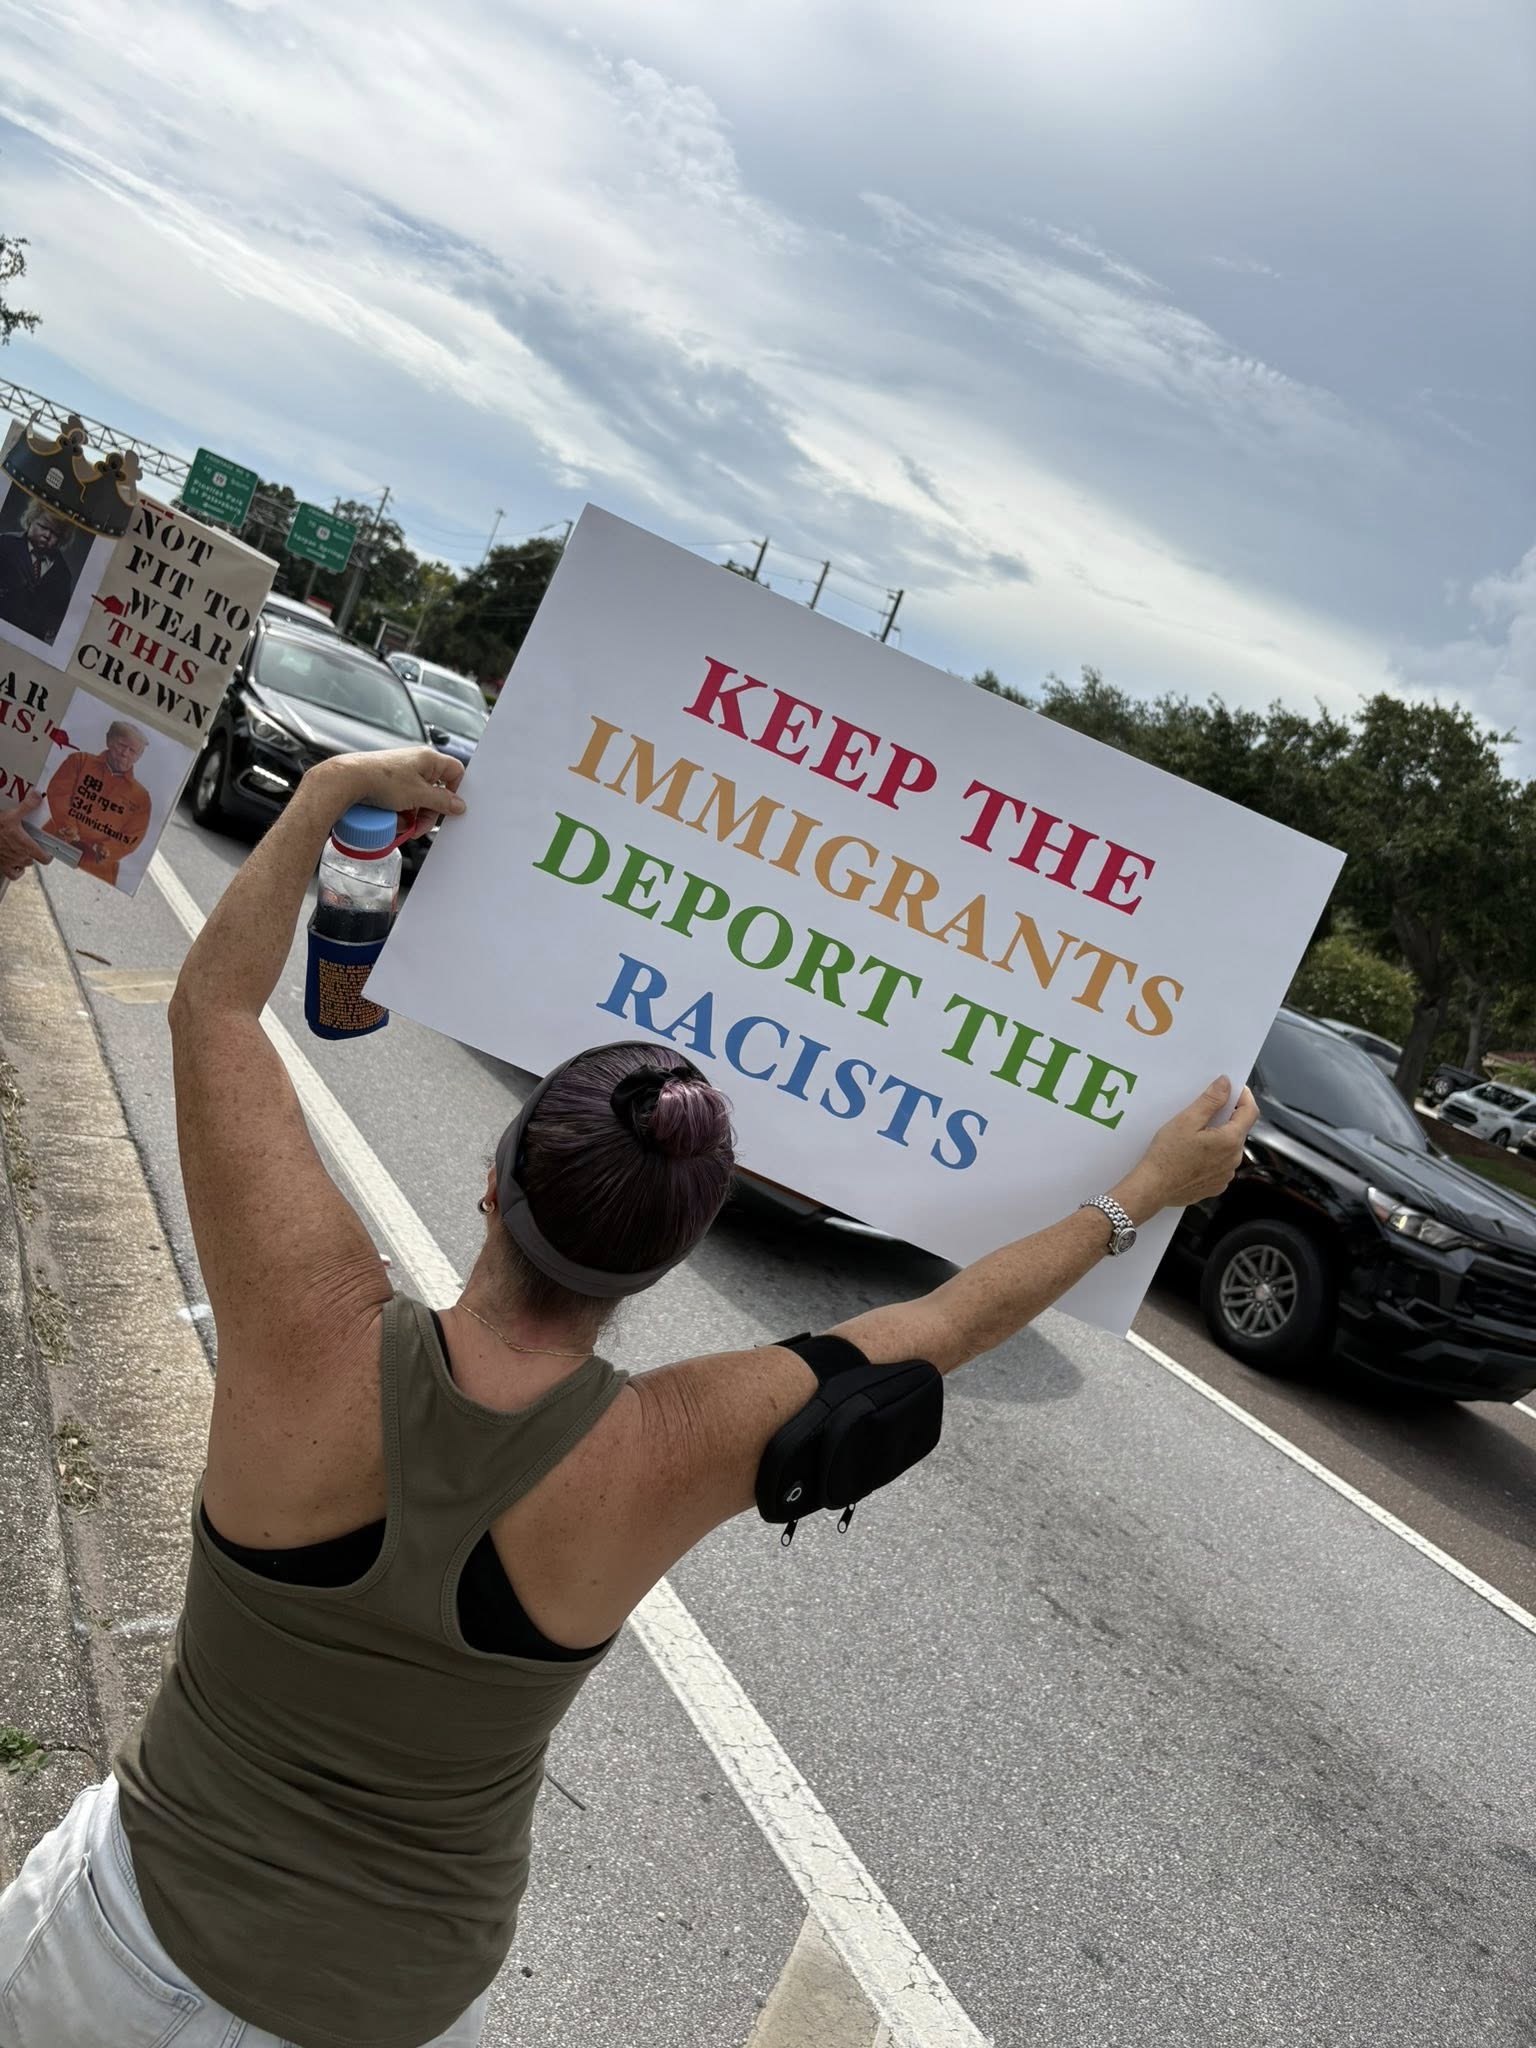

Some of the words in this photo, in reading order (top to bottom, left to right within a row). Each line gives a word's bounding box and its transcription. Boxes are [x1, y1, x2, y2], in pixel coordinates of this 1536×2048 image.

[133, 508, 214, 568] NOT
[125, 545, 194, 600] FIT
[204, 588, 250, 632] TO
[131, 587, 232, 665] WEAR
[107, 617, 200, 684] THIS
[72, 796, 93, 815] 34
[683, 656, 938, 811] KEEP
[960, 779, 1156, 916] THE
[568, 715, 1185, 1037] IMMIGRANTS
[532, 811, 923, 1027] DEPORT
[941, 993, 1138, 1130] THE
[596, 952, 989, 1171] RACISTS
